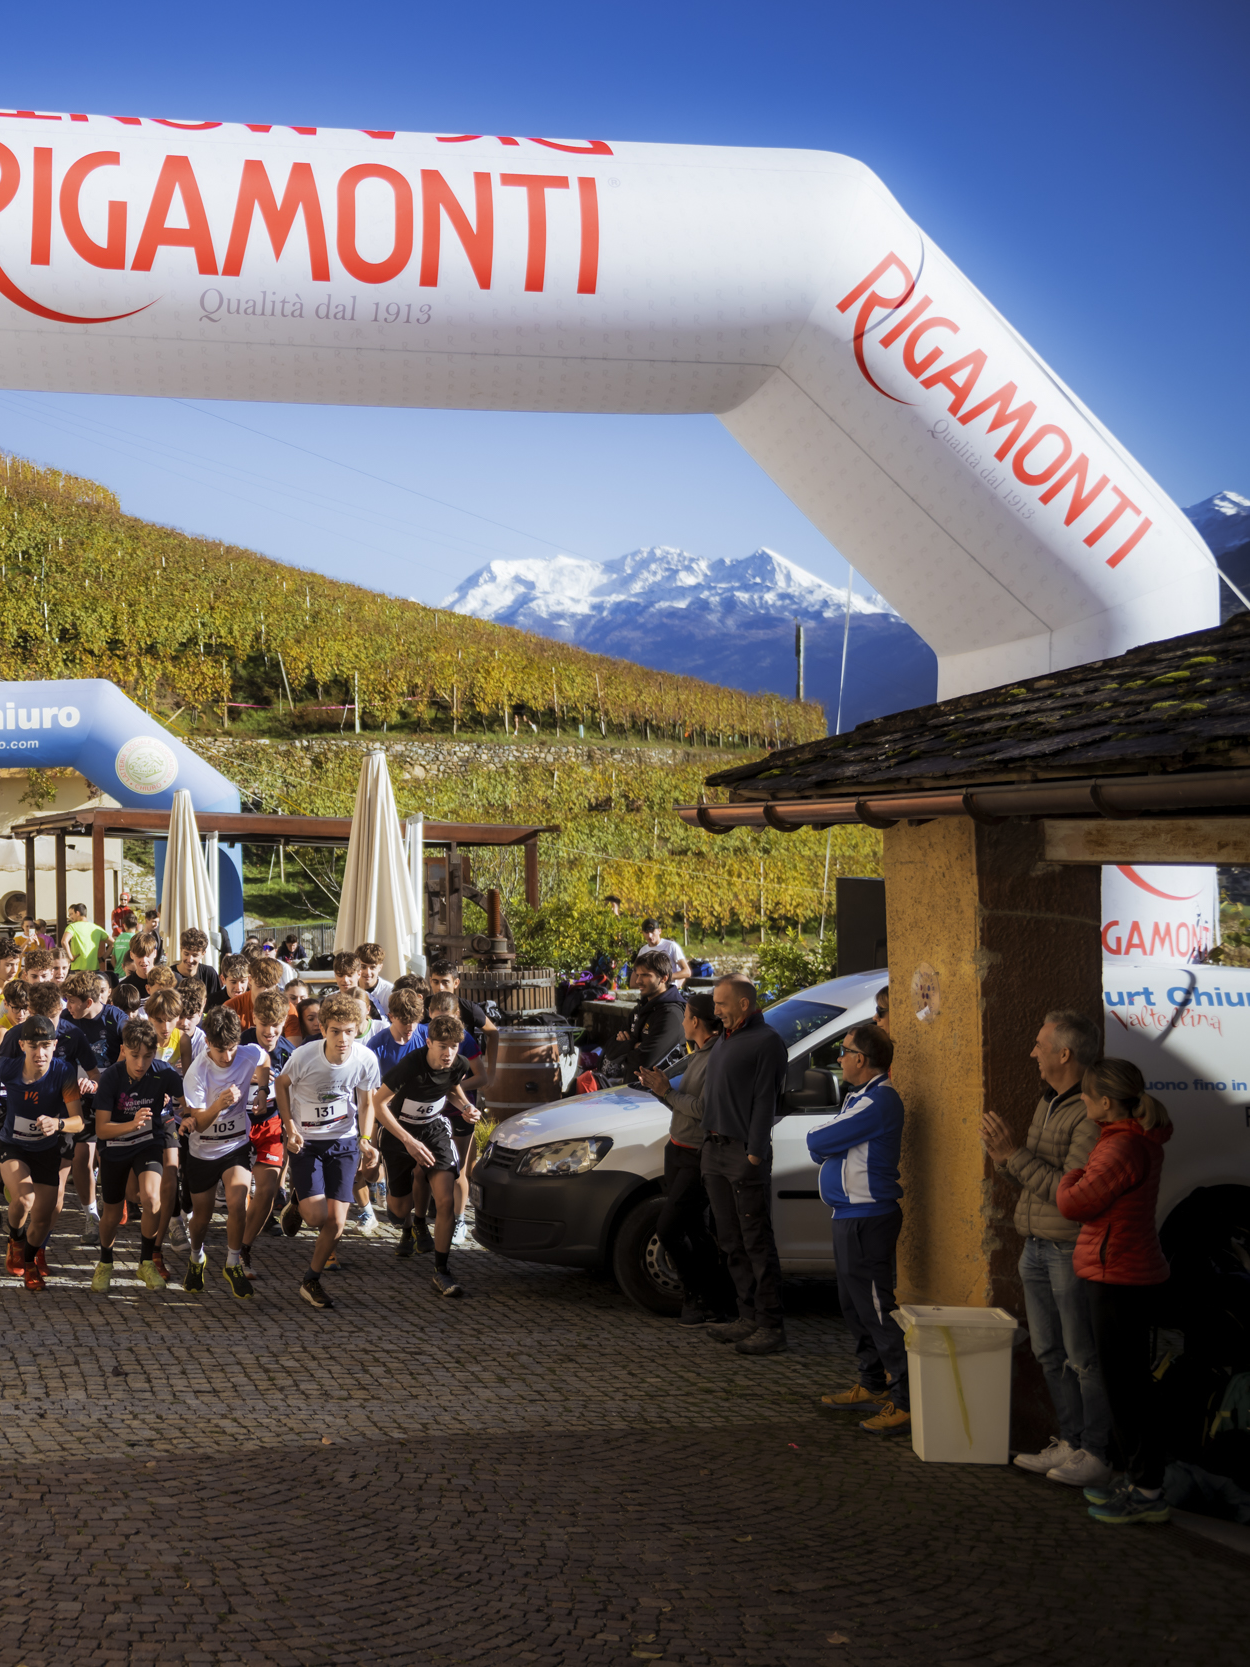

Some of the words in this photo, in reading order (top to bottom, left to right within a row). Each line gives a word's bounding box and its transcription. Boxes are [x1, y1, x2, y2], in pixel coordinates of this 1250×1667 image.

[199, 288, 305, 323] Qualità
[314, 293, 358, 322] dal
[370, 302, 434, 326] 1913
[835, 250, 1154, 570] RIGAMONTI
[927, 419, 982, 469] Qualità
[980, 467, 1006, 490] dal
[1003, 489, 1035, 519] 1913
[1104, 987, 1156, 1006] urt
[1109, 997, 1222, 1037] Valtellina
[1144, 1081, 1188, 1091] uono
[1192, 1079, 1227, 1091] fino
[1232, 1080, 1247, 1091] in
[315, 1106, 334, 1118] 131
[416, 1105, 434, 1115] 46
[213, 1120, 235, 1133] 103
